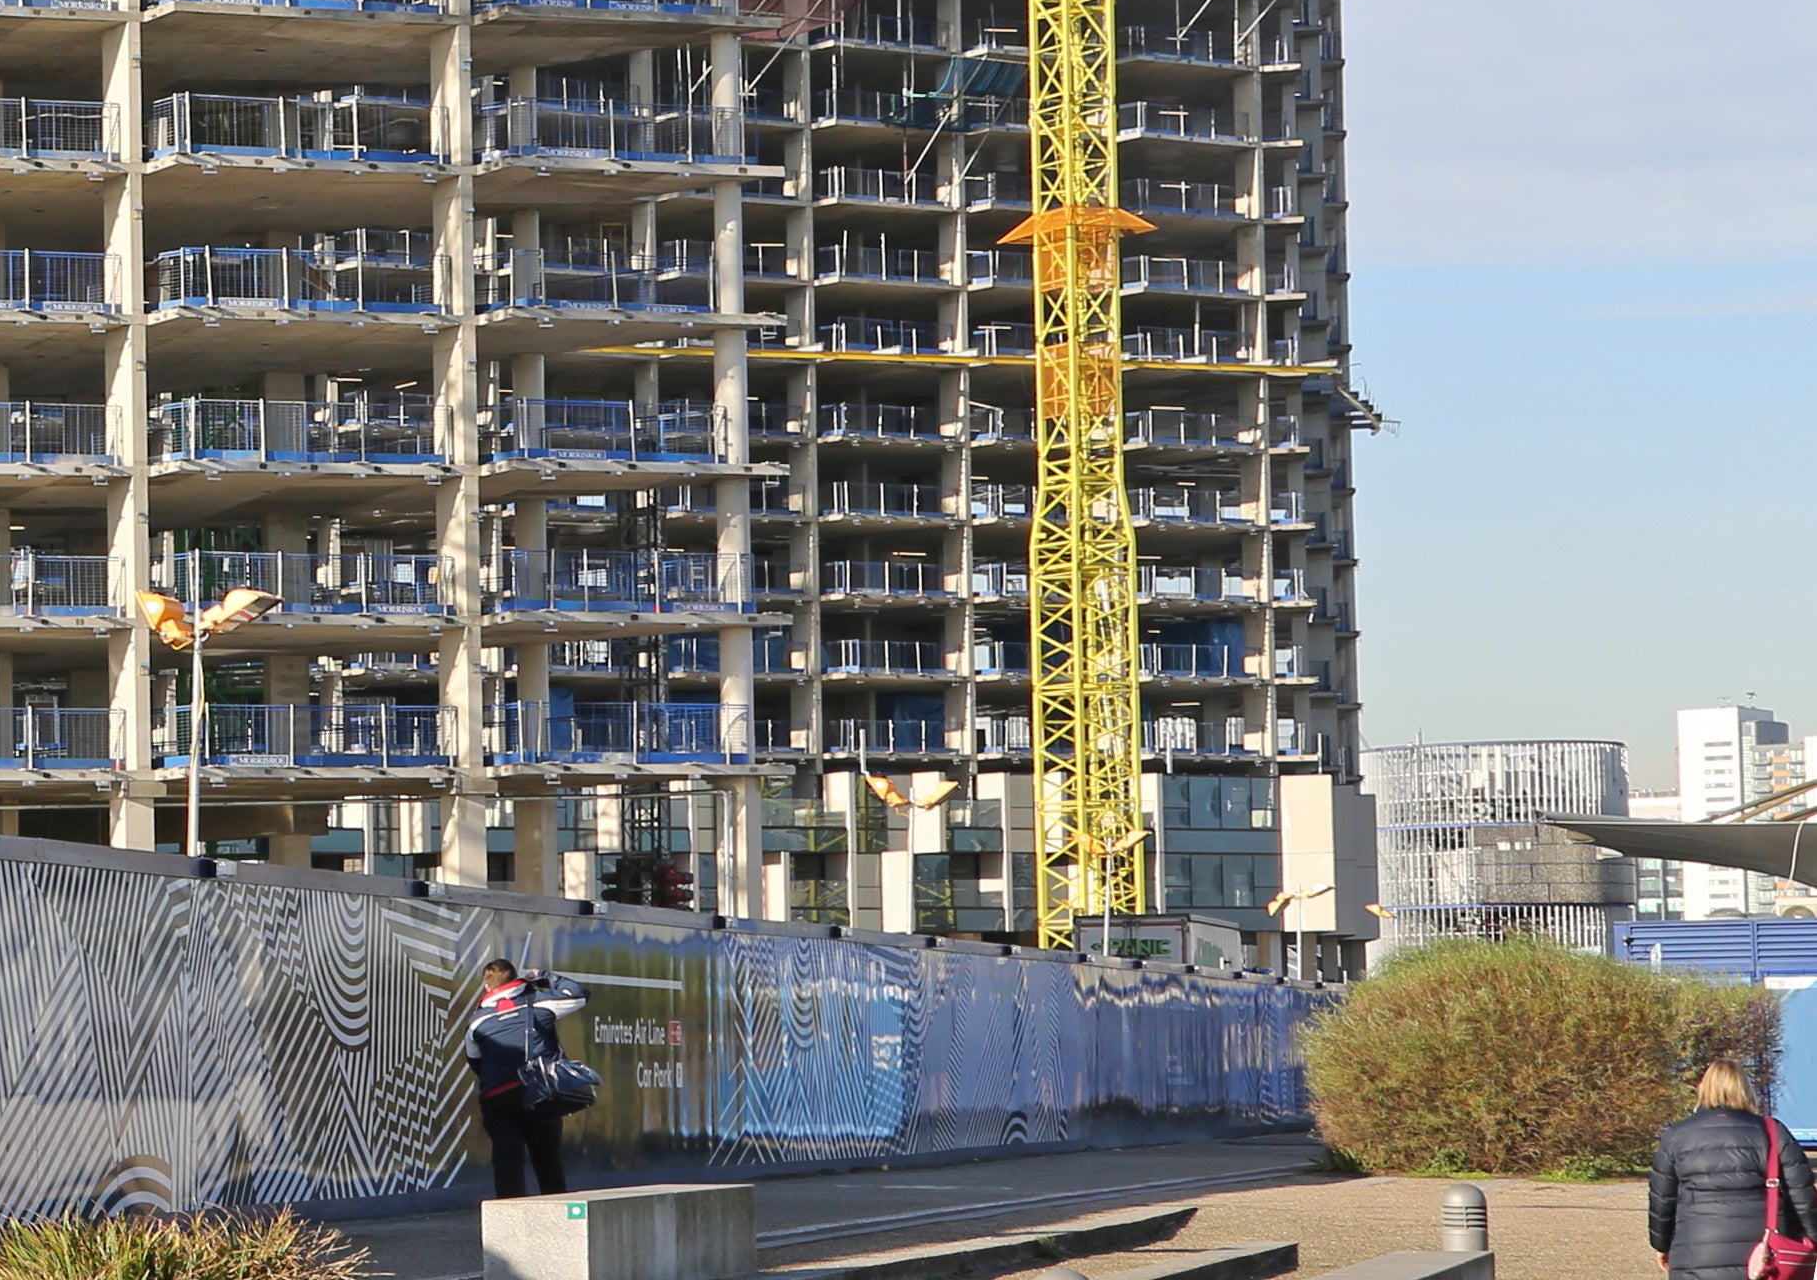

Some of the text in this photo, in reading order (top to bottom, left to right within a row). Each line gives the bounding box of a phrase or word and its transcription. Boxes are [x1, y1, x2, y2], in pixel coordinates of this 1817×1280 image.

[594, 1016, 665, 1046] Emirates Air Line
[636, 1061, 652, 1088] Car
[653, 1061, 672, 1088] Park
